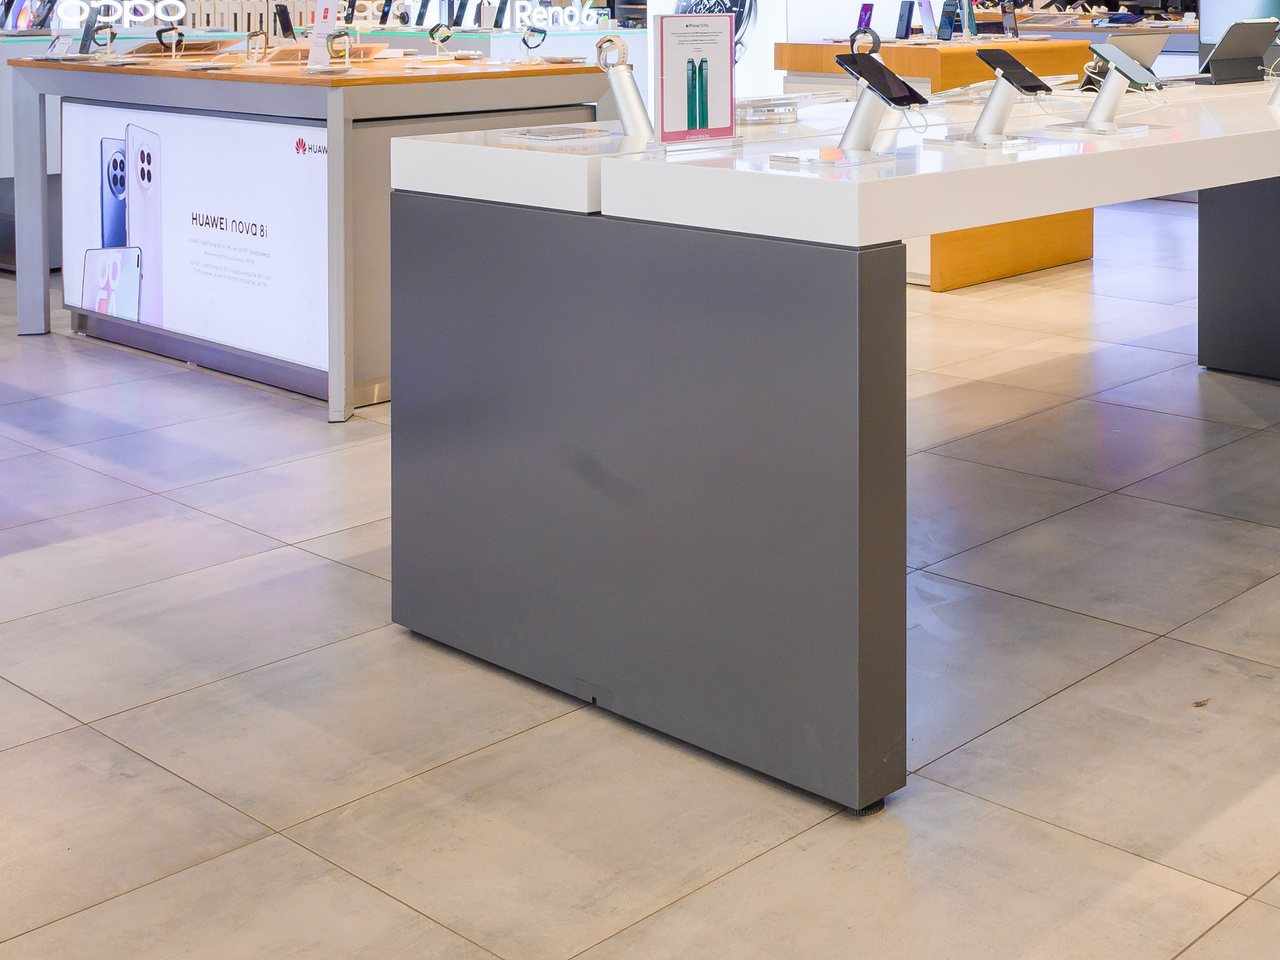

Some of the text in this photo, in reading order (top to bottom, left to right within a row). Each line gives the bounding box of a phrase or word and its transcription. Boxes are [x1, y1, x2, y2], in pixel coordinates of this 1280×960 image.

[515, 0, 598, 27] Reno6
[191, 211, 268, 238] HUAWEI nova 8i
